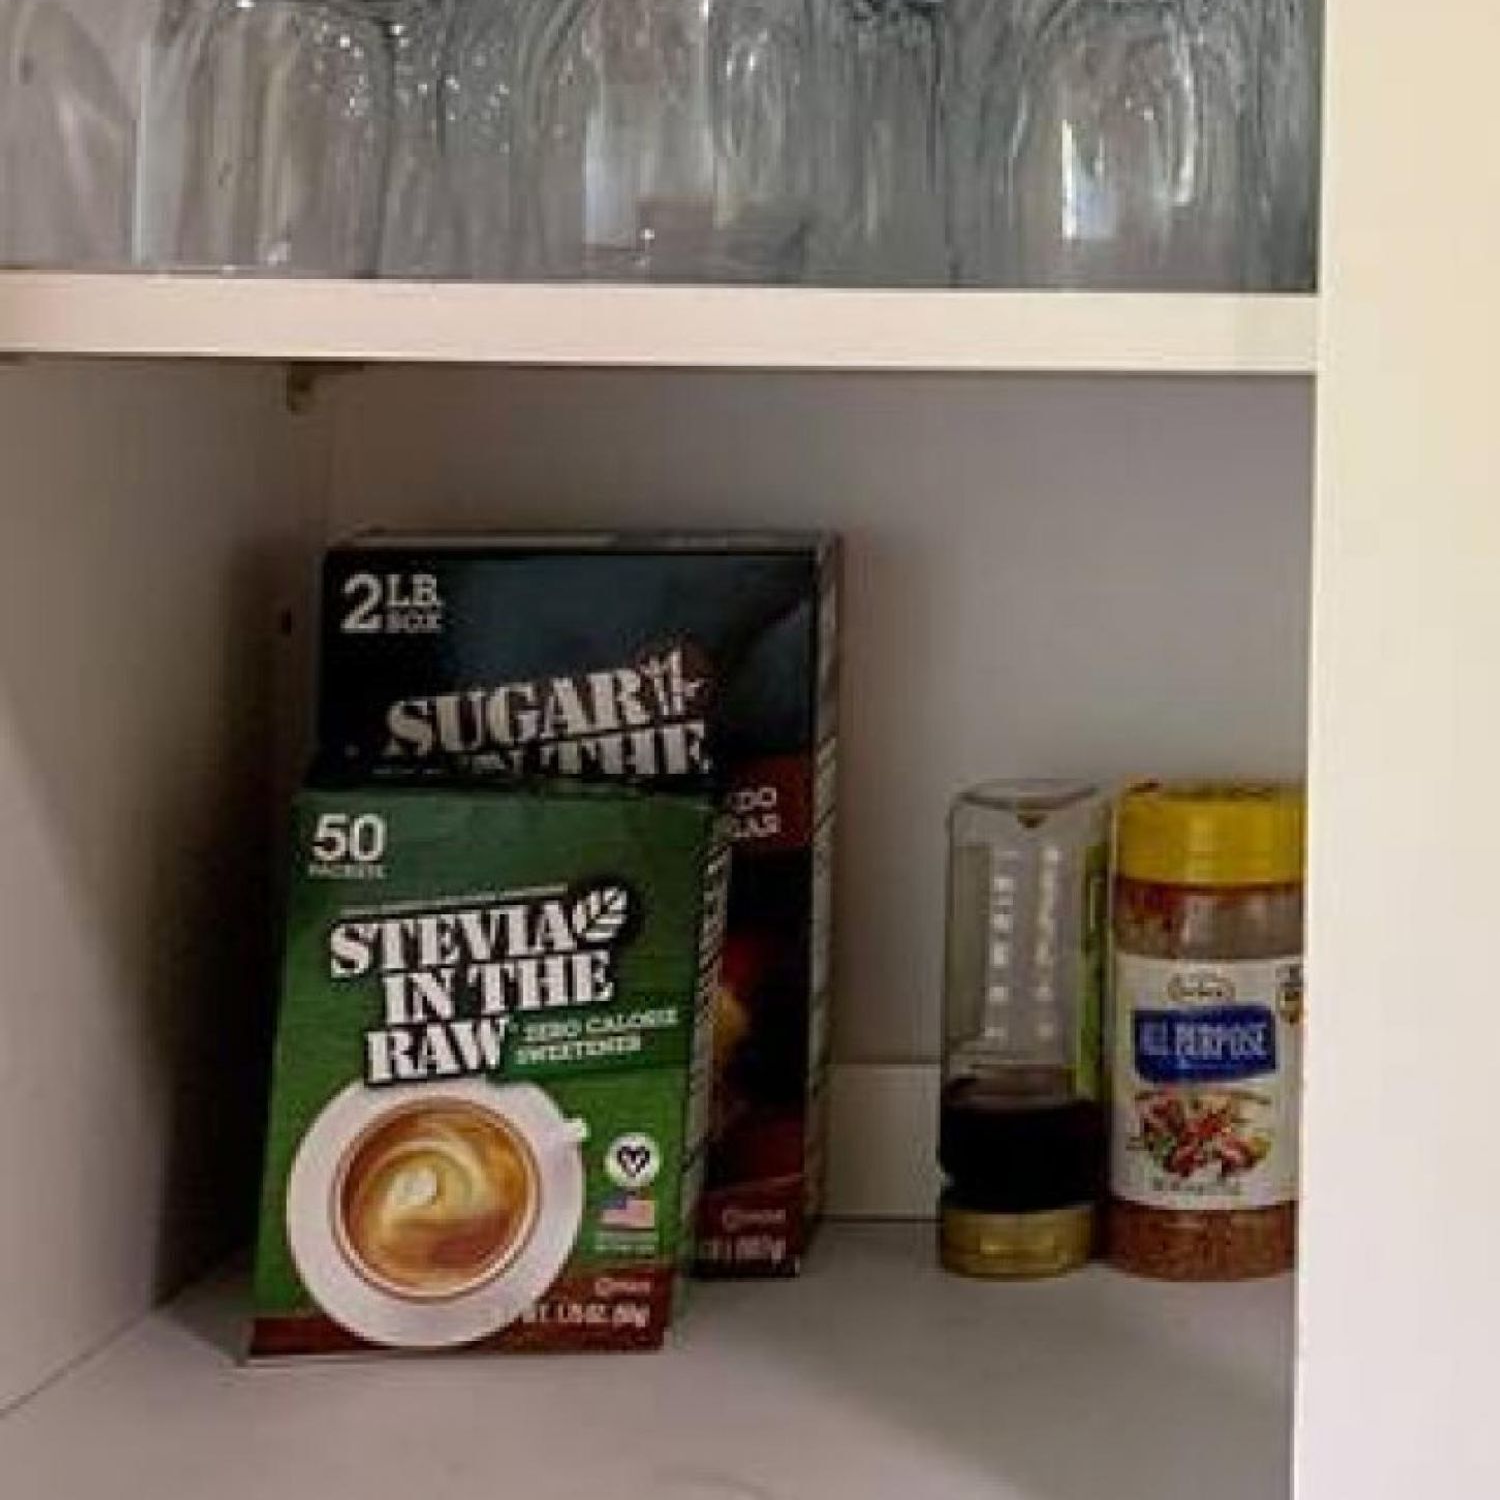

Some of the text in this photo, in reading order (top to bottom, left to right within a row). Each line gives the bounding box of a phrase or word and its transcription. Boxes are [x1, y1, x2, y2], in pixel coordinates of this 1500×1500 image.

[340, 574, 383, 633] 2
[385, 668, 651, 757] SUGAR
[310, 812, 388, 861] 50
[331, 903, 577, 976] STEVIA
[382, 951, 613, 1025] IN THE
[365, 1016, 510, 1085] RAW
